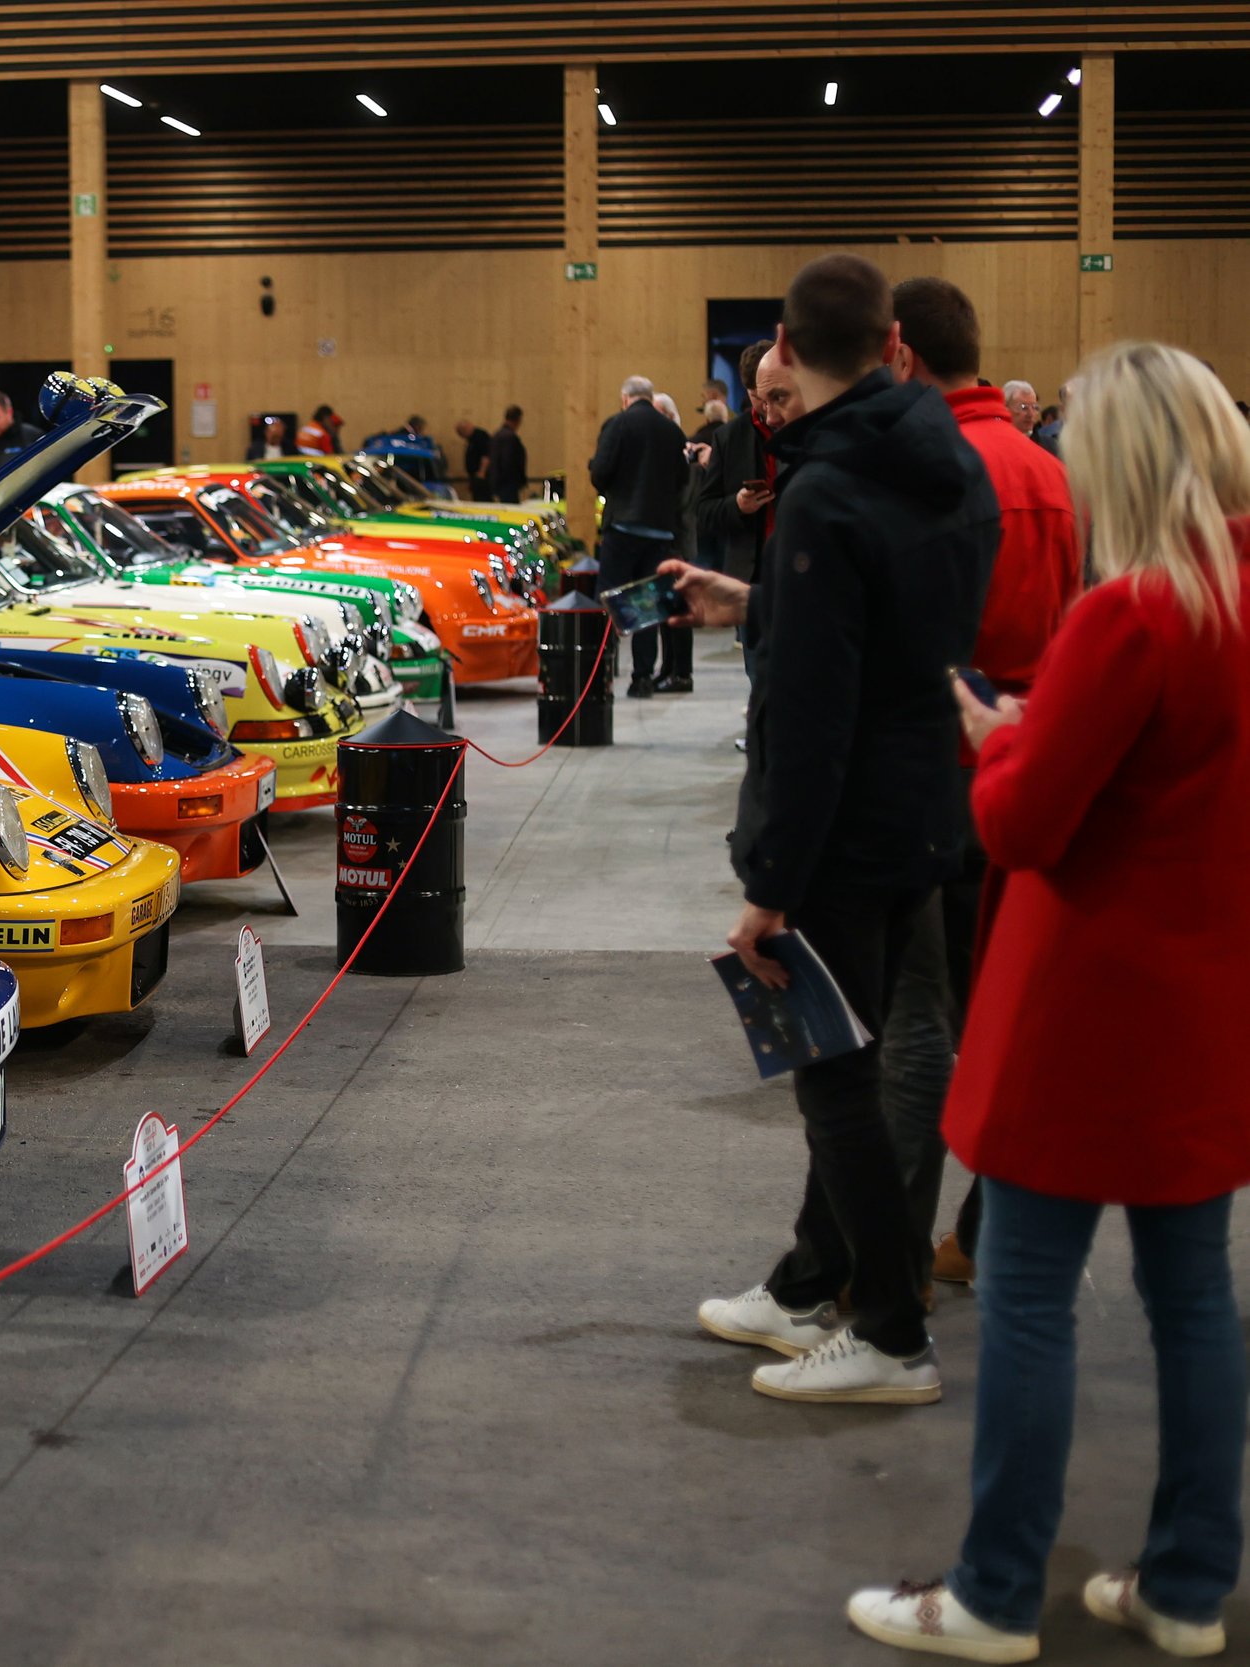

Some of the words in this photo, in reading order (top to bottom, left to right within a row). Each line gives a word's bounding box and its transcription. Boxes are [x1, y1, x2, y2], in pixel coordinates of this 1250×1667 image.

[344, 832, 377, 845] MOTUL
[339, 867, 388, 887] MOTUL
[132, 899, 153, 926] GARAGE
